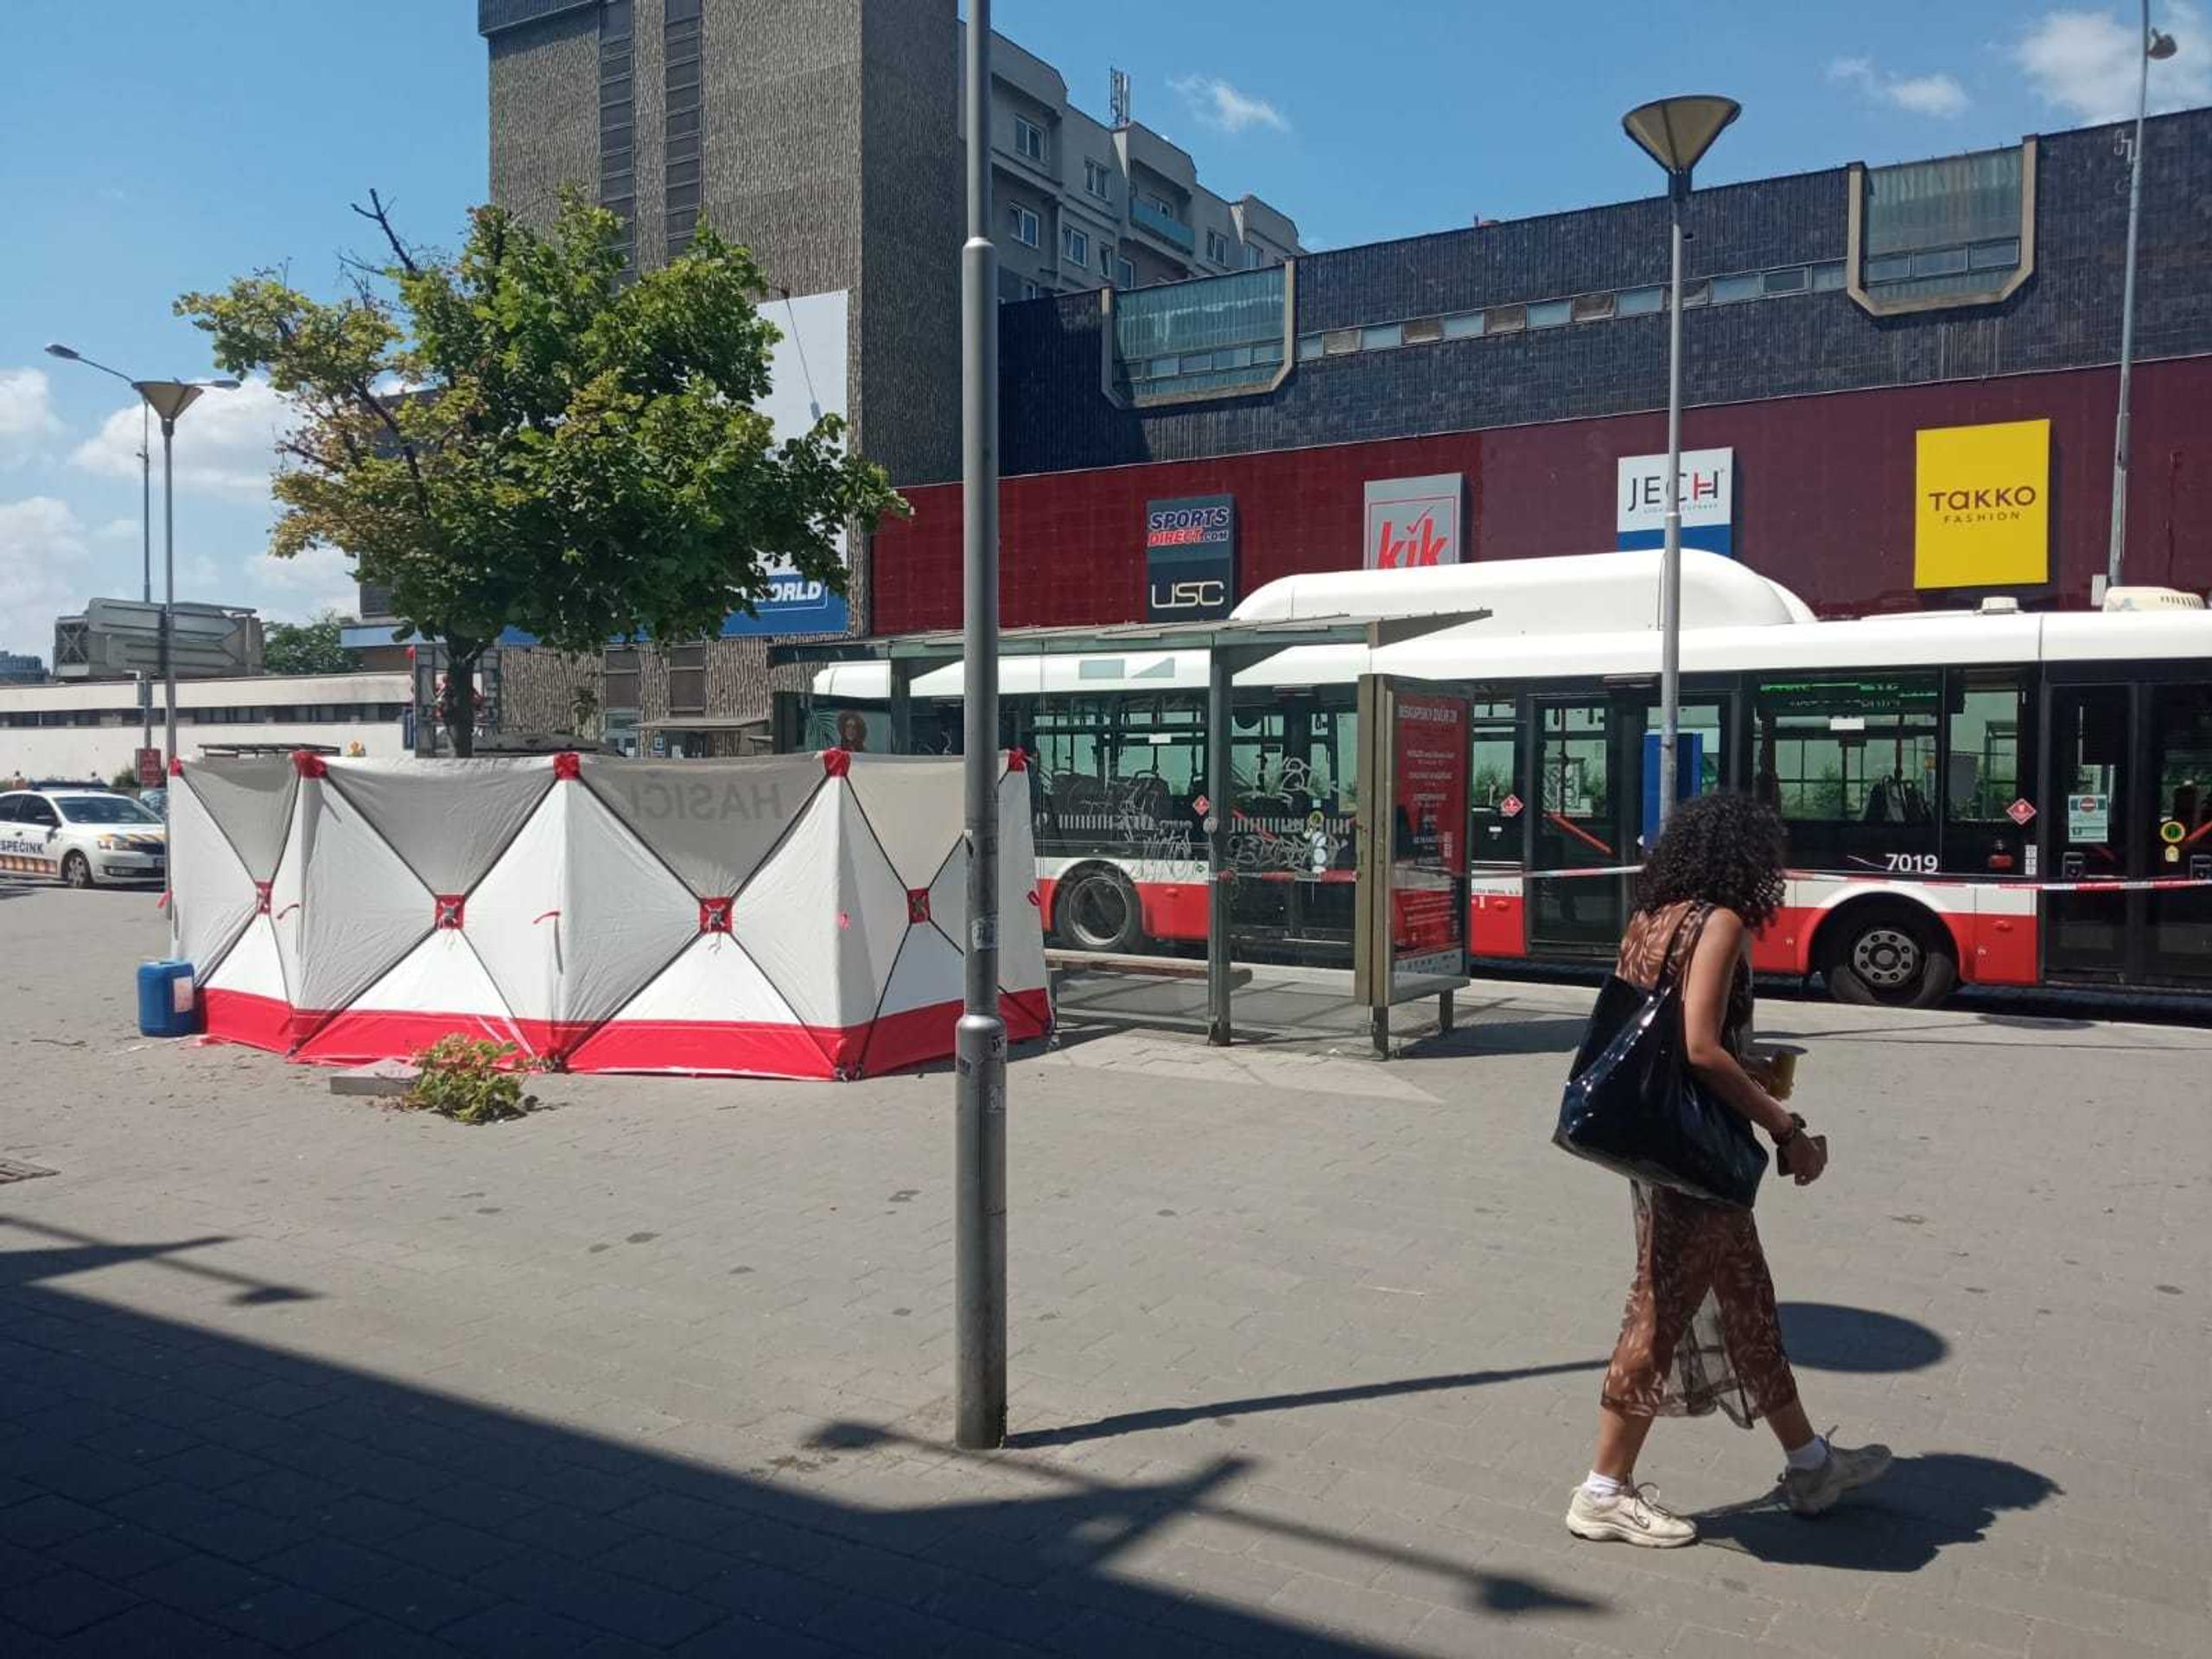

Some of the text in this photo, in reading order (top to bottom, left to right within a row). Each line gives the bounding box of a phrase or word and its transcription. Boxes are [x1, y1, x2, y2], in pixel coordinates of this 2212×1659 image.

[1149, 505, 1230, 531] SPORTS
[1944, 511, 2021, 524] FASHION
[1151, 581, 1224, 608] USC
[1885, 853, 1938, 874] 7019
